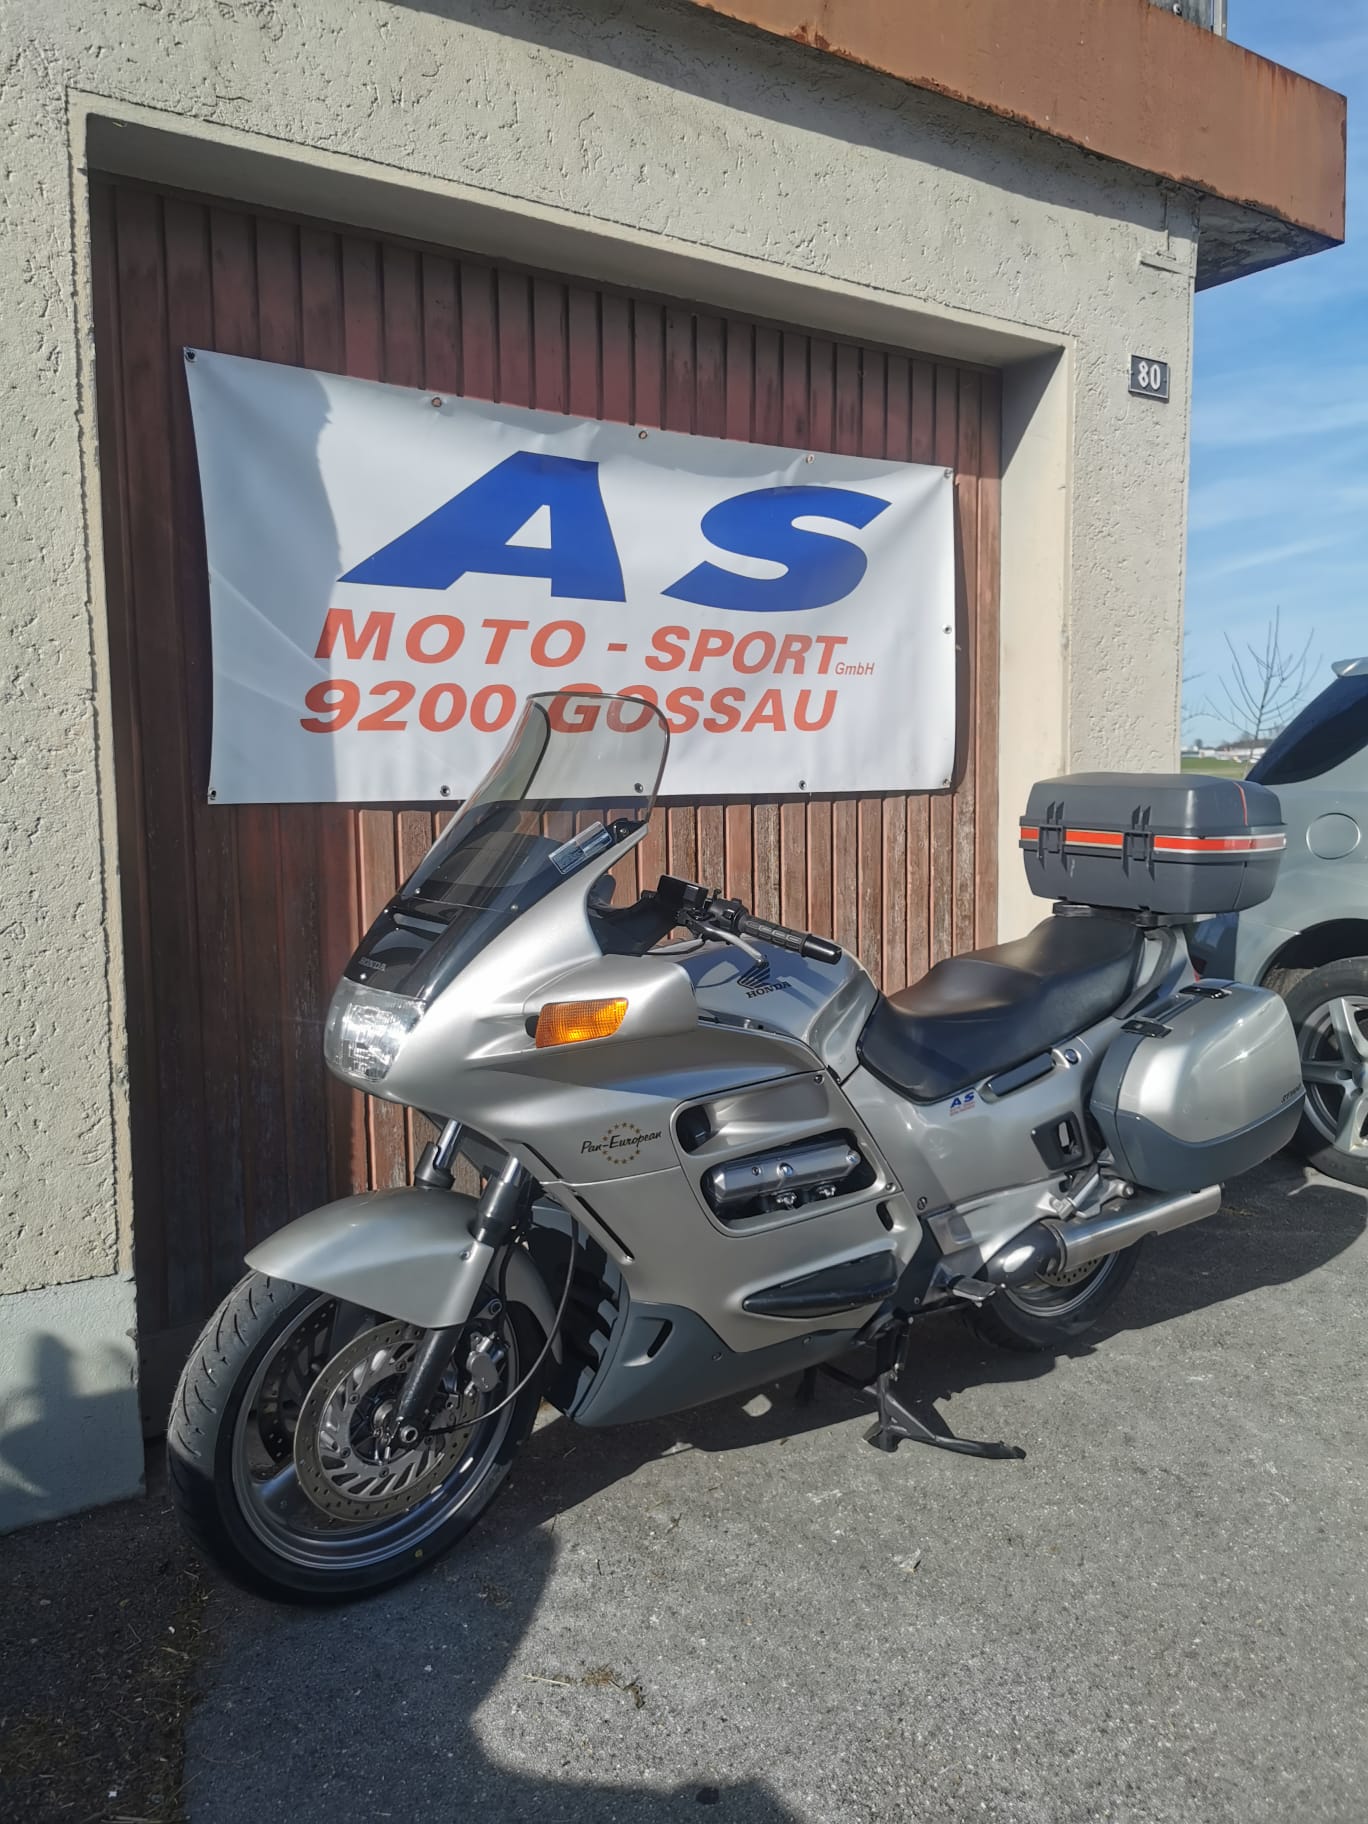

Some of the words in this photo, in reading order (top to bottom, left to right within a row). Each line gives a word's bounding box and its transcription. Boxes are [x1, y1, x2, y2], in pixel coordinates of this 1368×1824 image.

[1138, 361, 1161, 390] 80
[314, 608, 586, 667] MOTO
[645, 625, 849, 675] SPORT
[834, 662, 875, 676] GmbH
[300, 679, 516, 733] 9200
[548, 683, 838, 733] GOSSAU
[745, 981, 792, 999] HONDA
[580, 1131, 662, 1154] Pan-European
